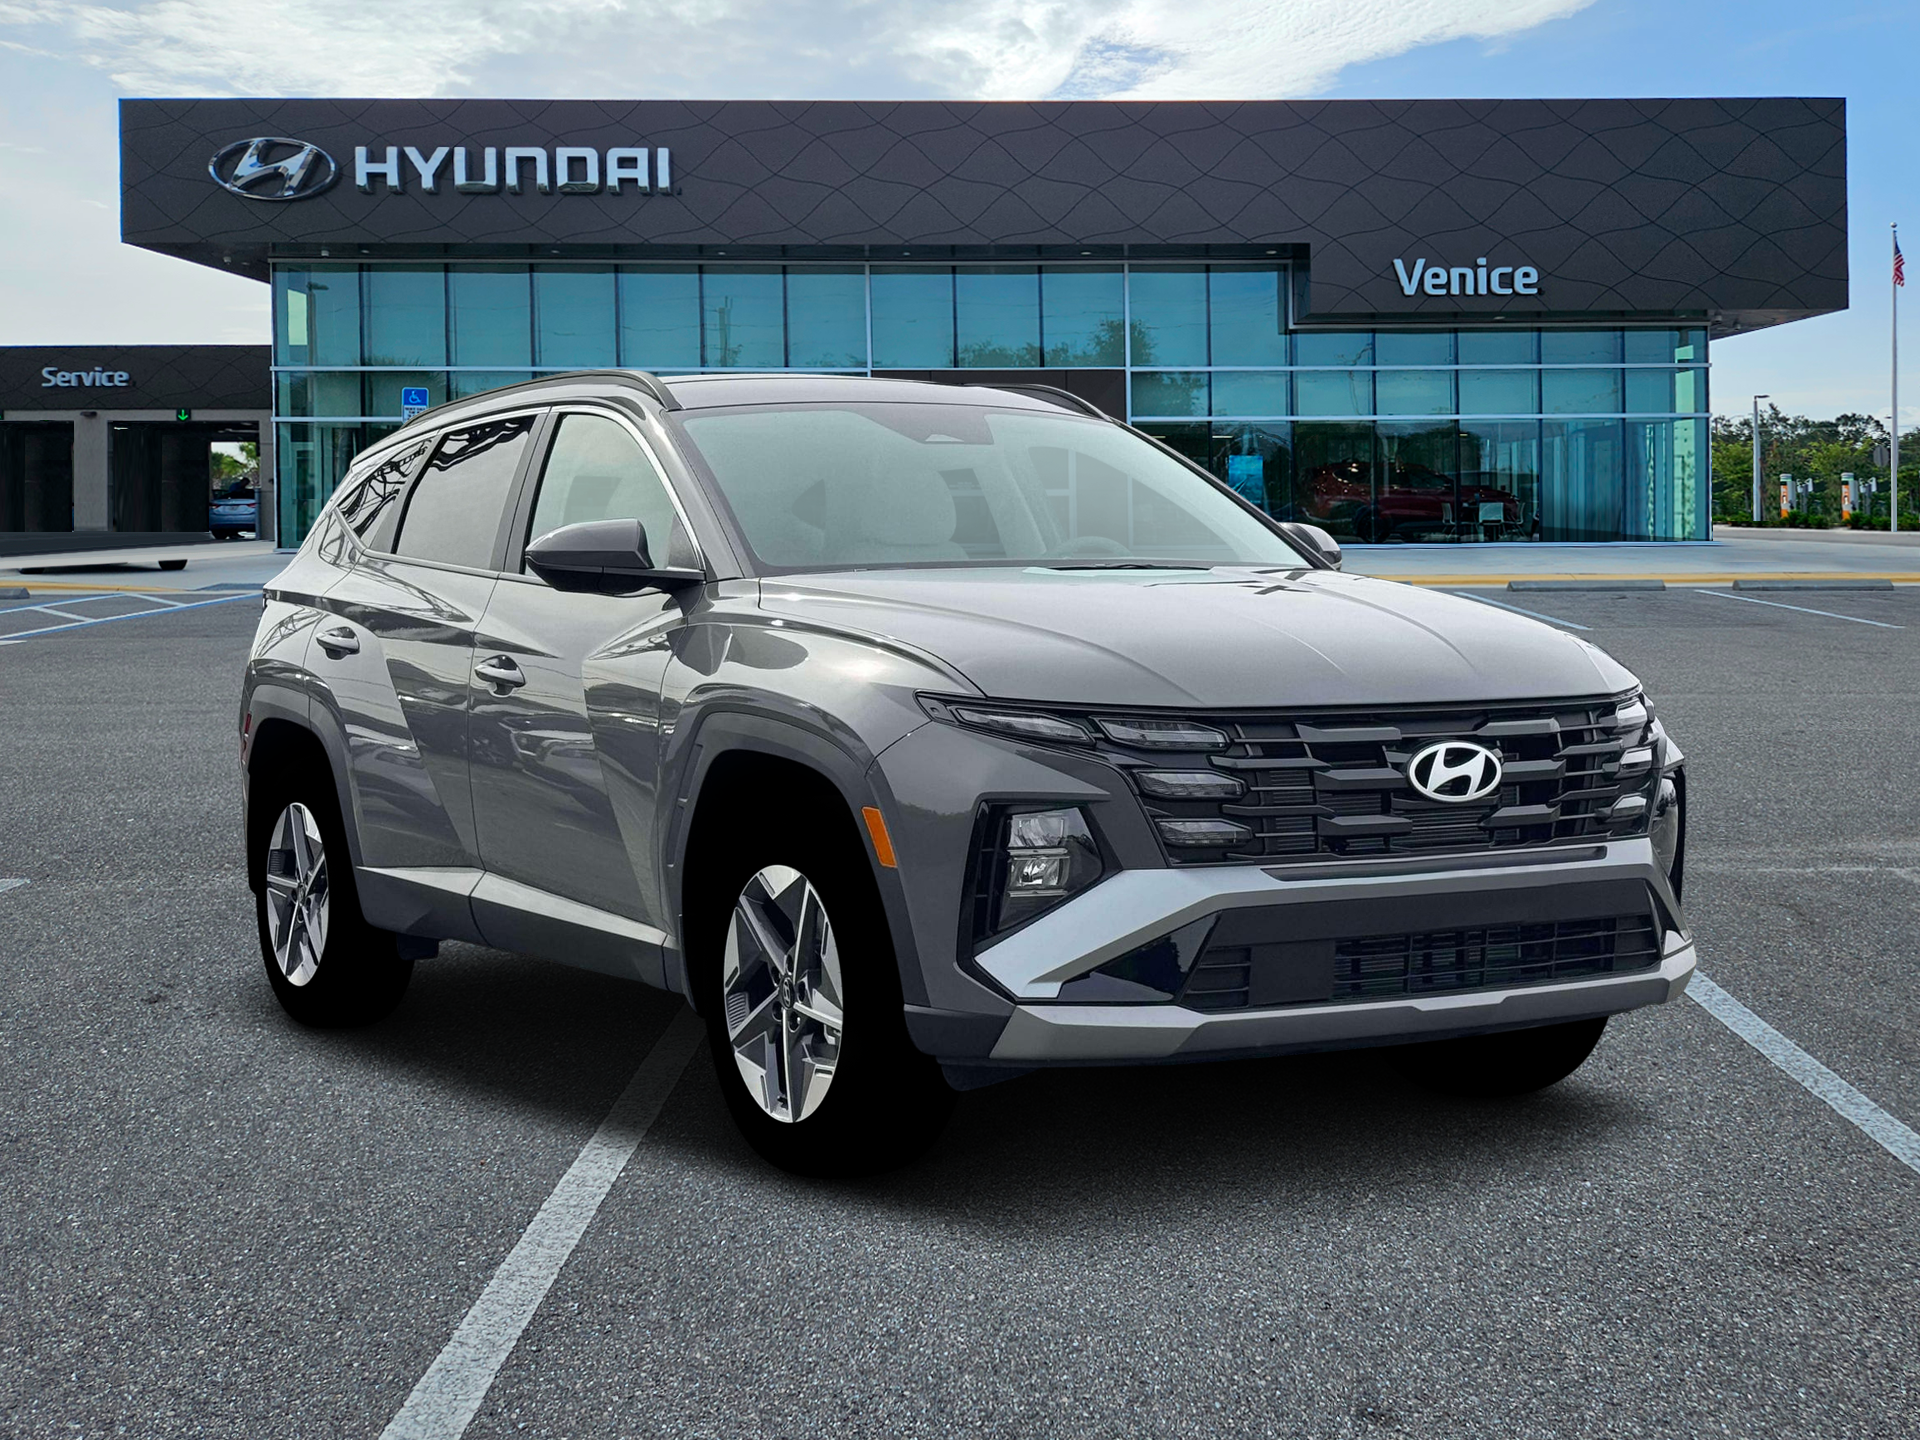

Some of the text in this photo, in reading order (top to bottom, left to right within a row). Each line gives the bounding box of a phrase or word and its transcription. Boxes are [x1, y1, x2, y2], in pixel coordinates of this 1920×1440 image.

[354, 145, 672, 194] HYUNDAI
[1392, 257, 1539, 296] Venice
[41, 366, 130, 387] Service
